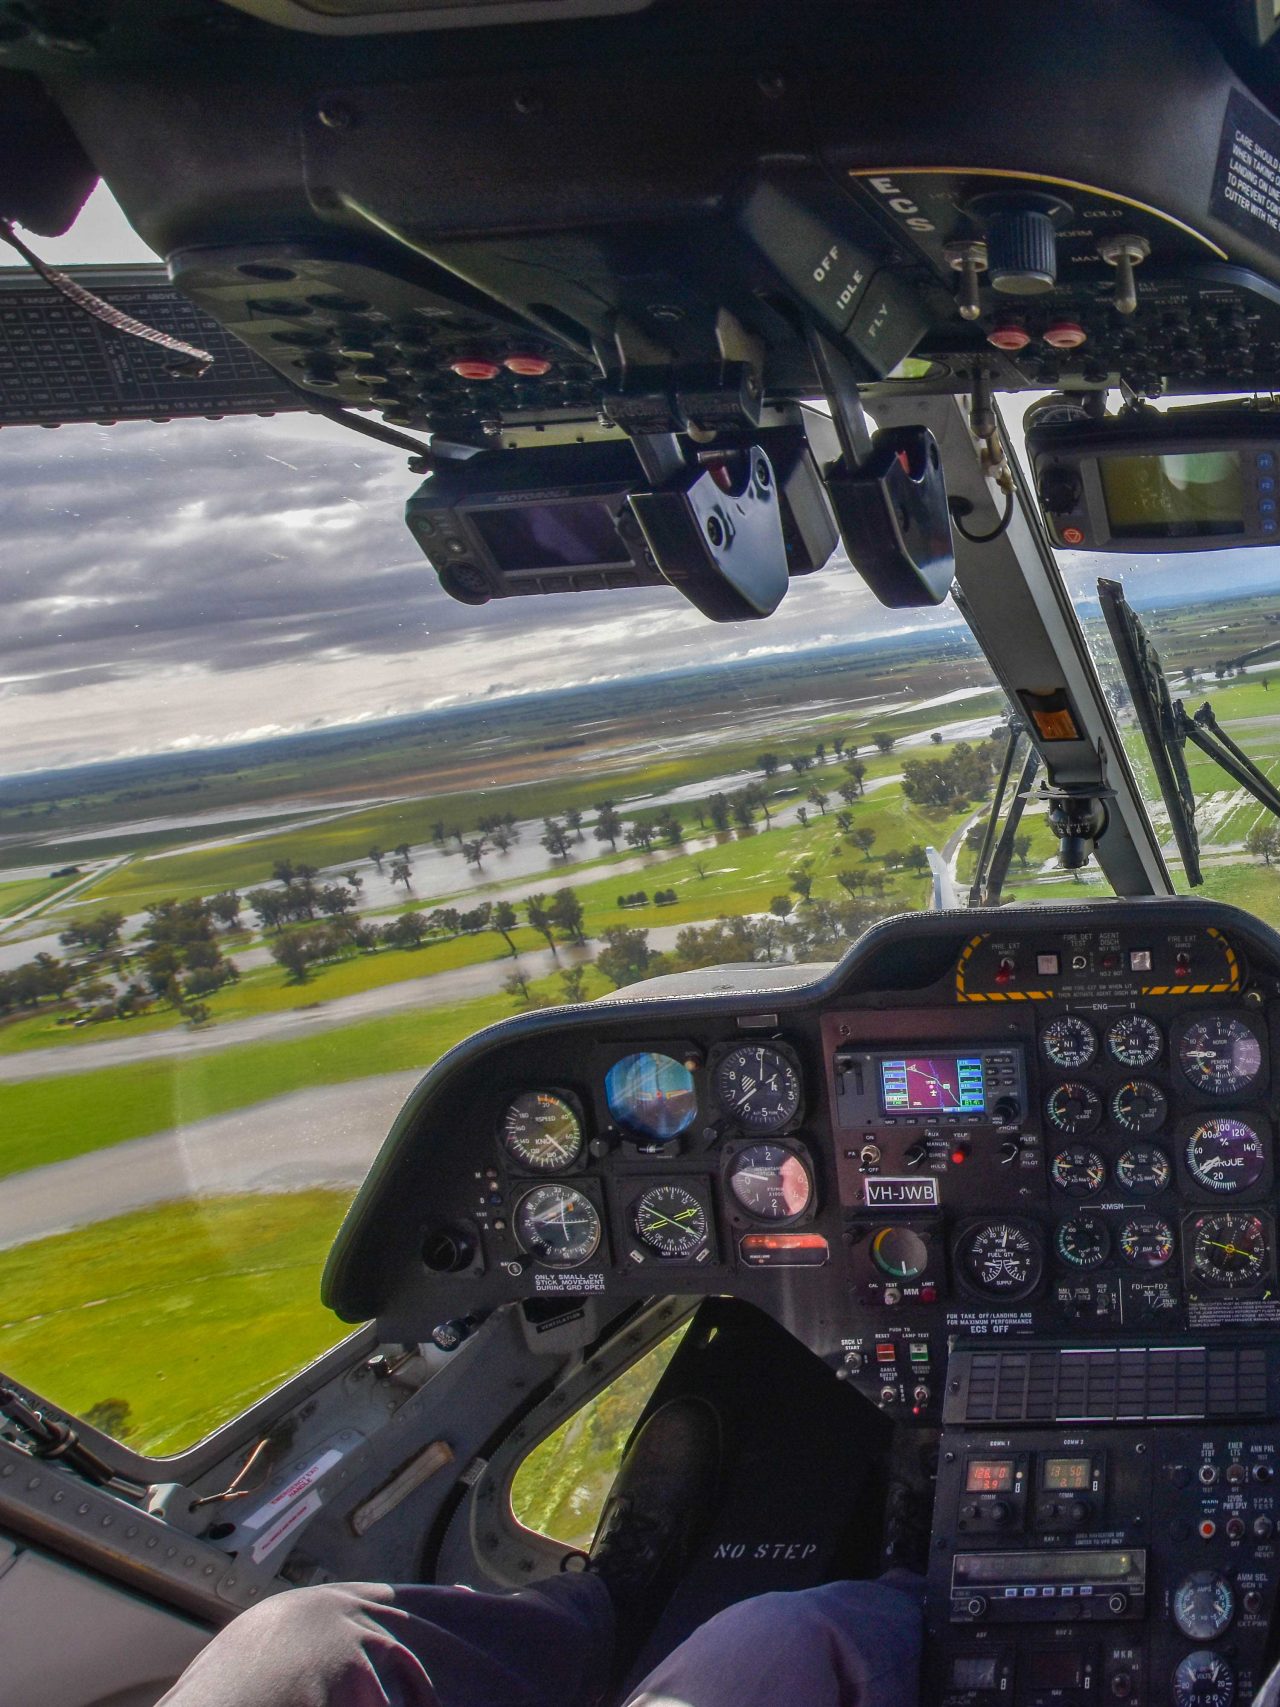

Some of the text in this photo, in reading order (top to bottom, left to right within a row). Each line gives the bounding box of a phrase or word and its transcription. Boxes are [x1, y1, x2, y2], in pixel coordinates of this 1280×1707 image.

[1233, 143, 1251, 165] WHEN
[1252, 157, 1275, 181] TAKING
[1235, 130, 1254, 150] CARE
[1254, 141, 1278, 168] SHOULD
[1228, 172, 1238, 187] TO
[1237, 179, 1266, 206] PREVENT
[1230, 158, 1258, 185] LANDING
[1258, 178, 1268, 193] ON
[1224, 186, 1250, 211] CUTTER
[1250, 203, 1266, 221] WITH
[1266, 213, 1278, 229] THE
[813, 246, 839, 282] OFF
[836, 269, 864, 309] IDLE
[868, 303, 888, 337] FLY
[868, 1185, 934, 1201] VH-JWB
[970, 1325, 1010, 1333] ECS OFF
[713, 1543, 817, 1559] NO STEP
